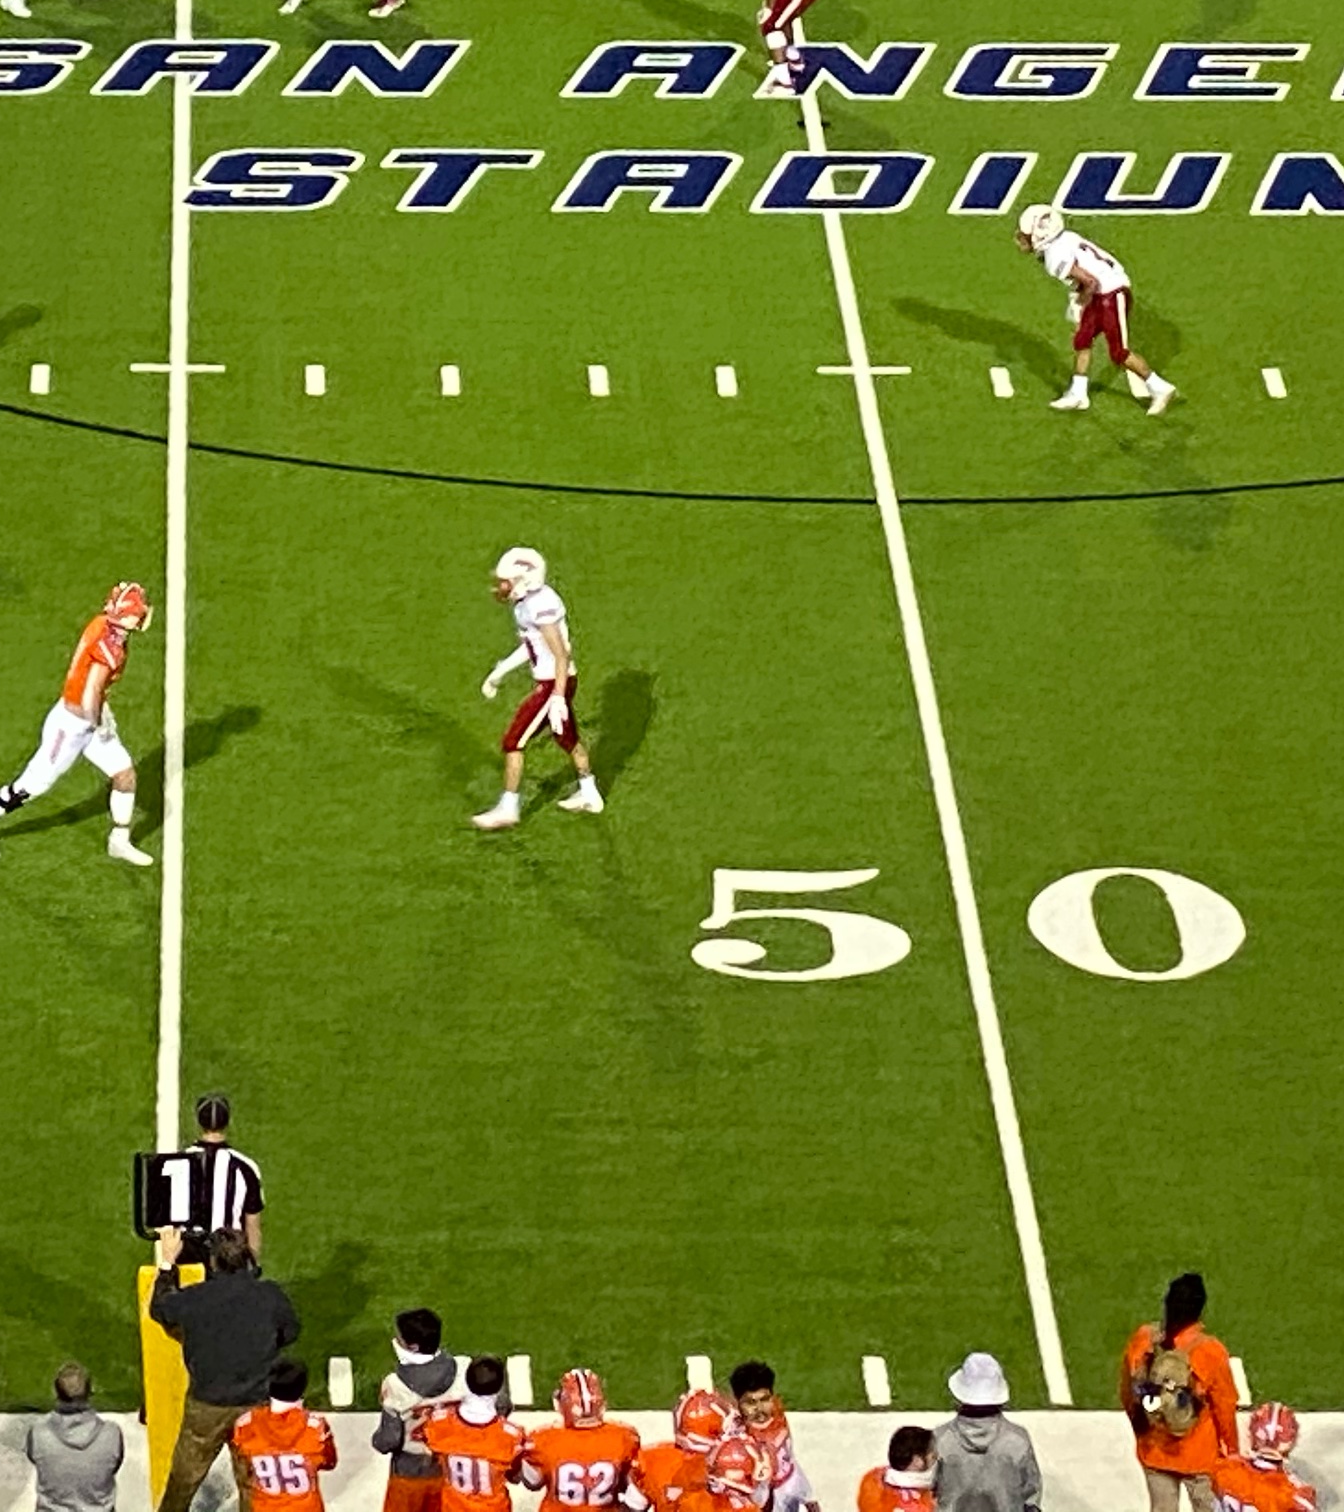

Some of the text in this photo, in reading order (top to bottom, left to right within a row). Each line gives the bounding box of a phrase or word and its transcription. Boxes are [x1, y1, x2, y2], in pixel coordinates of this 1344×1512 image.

[691, 867, 1246, 982] 50
[162, 1159, 190, 1223] 1
[558, 1462, 615, 1506] 62
